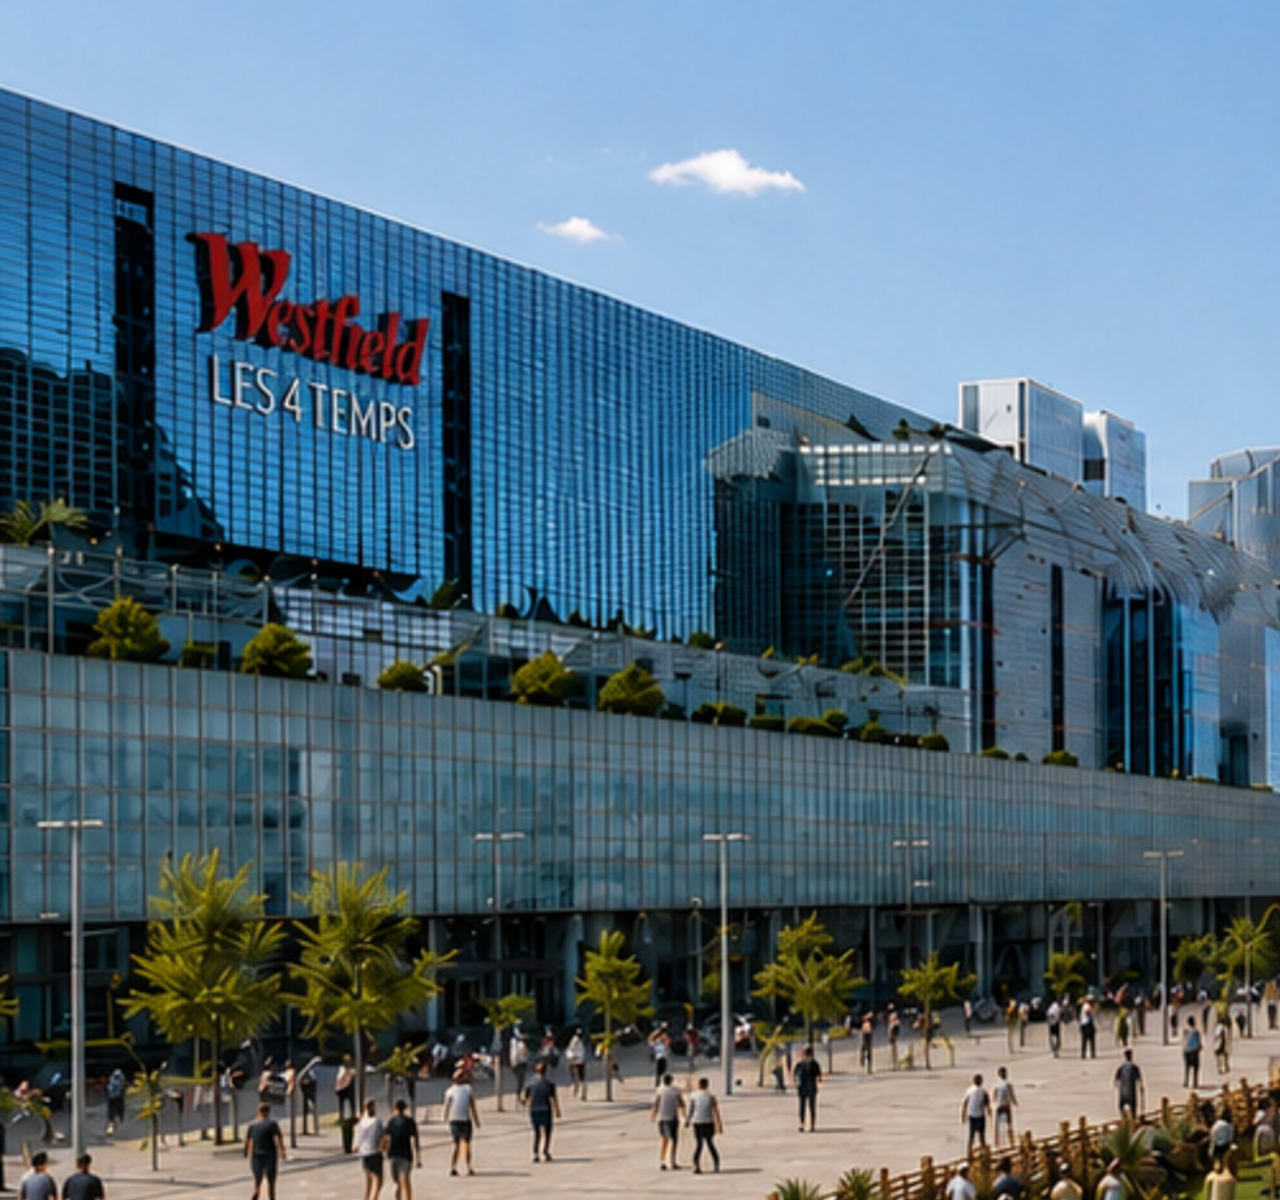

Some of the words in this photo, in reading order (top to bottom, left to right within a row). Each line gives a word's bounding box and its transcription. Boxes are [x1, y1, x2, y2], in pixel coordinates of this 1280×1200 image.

[189, 232, 430, 386] Westfield
[211, 354, 278, 416] LES
[284, 378, 304, 421] 4
[309, 381, 415, 450] TEMPS
